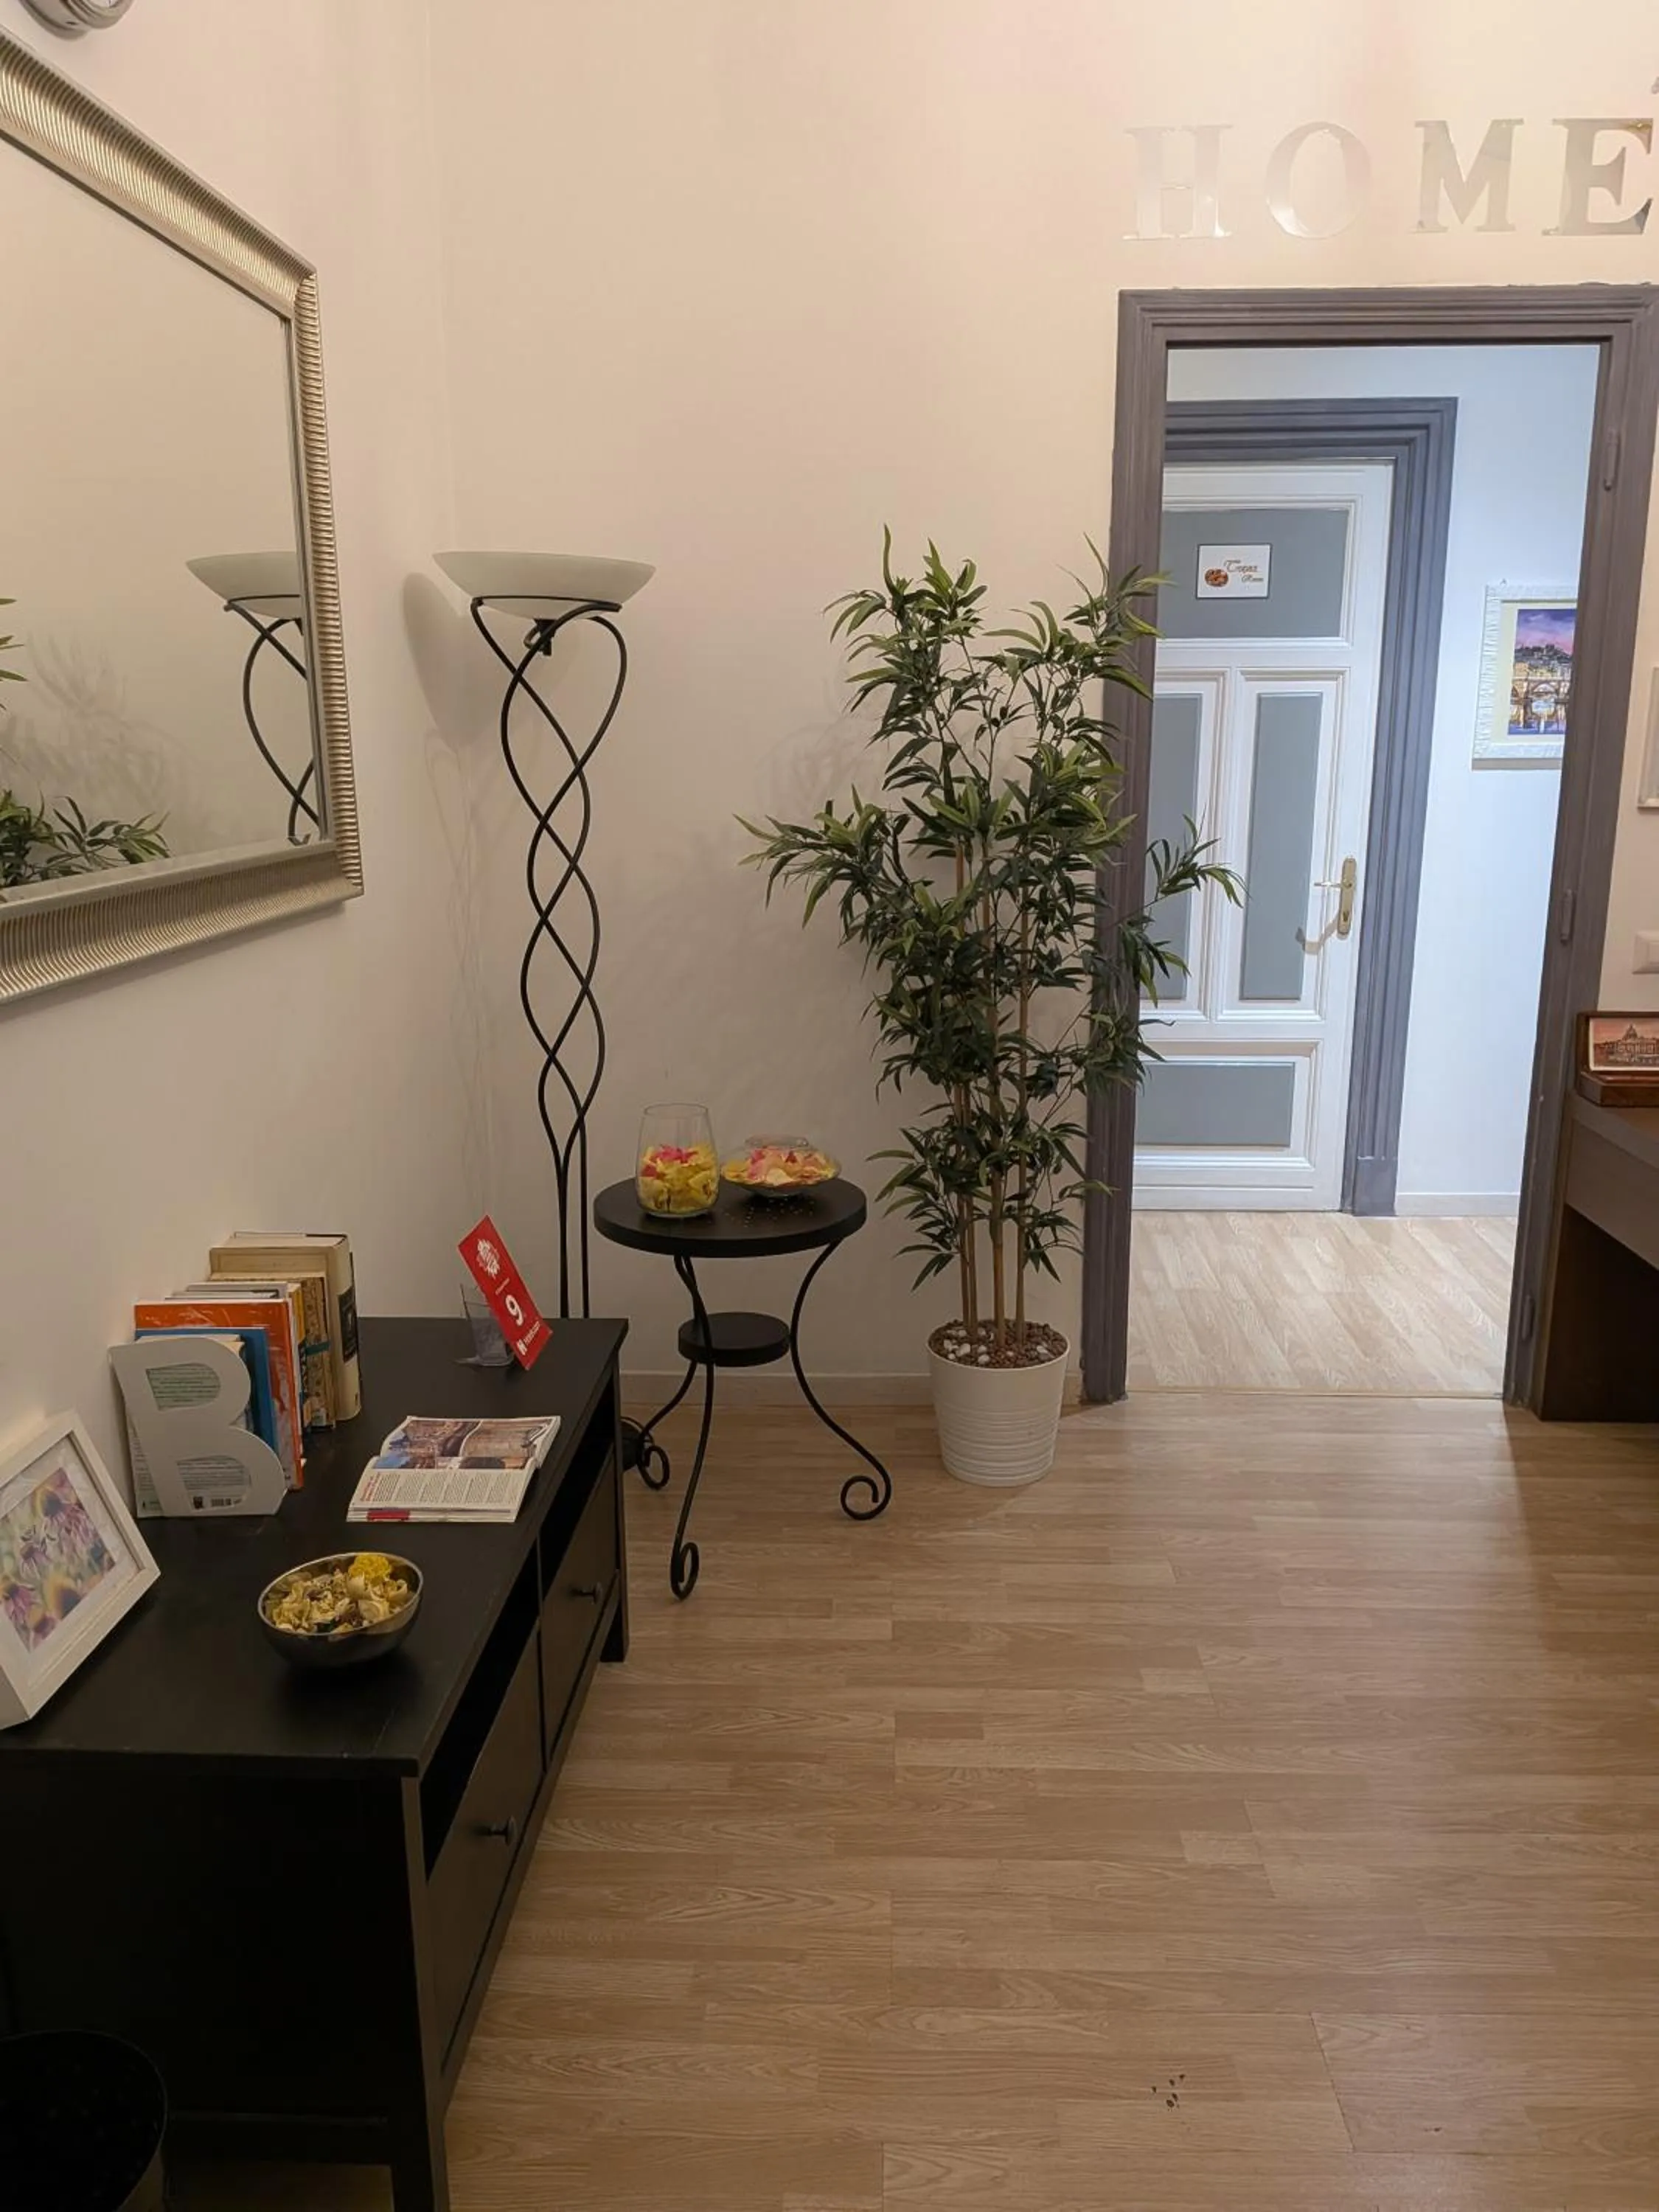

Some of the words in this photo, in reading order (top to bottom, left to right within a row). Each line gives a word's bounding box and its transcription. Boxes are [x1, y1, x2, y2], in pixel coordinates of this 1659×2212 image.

[1122, 116, 1654, 240] HOME
[504, 1294, 524, 1326] 9
[108, 1337, 288, 1517] B
